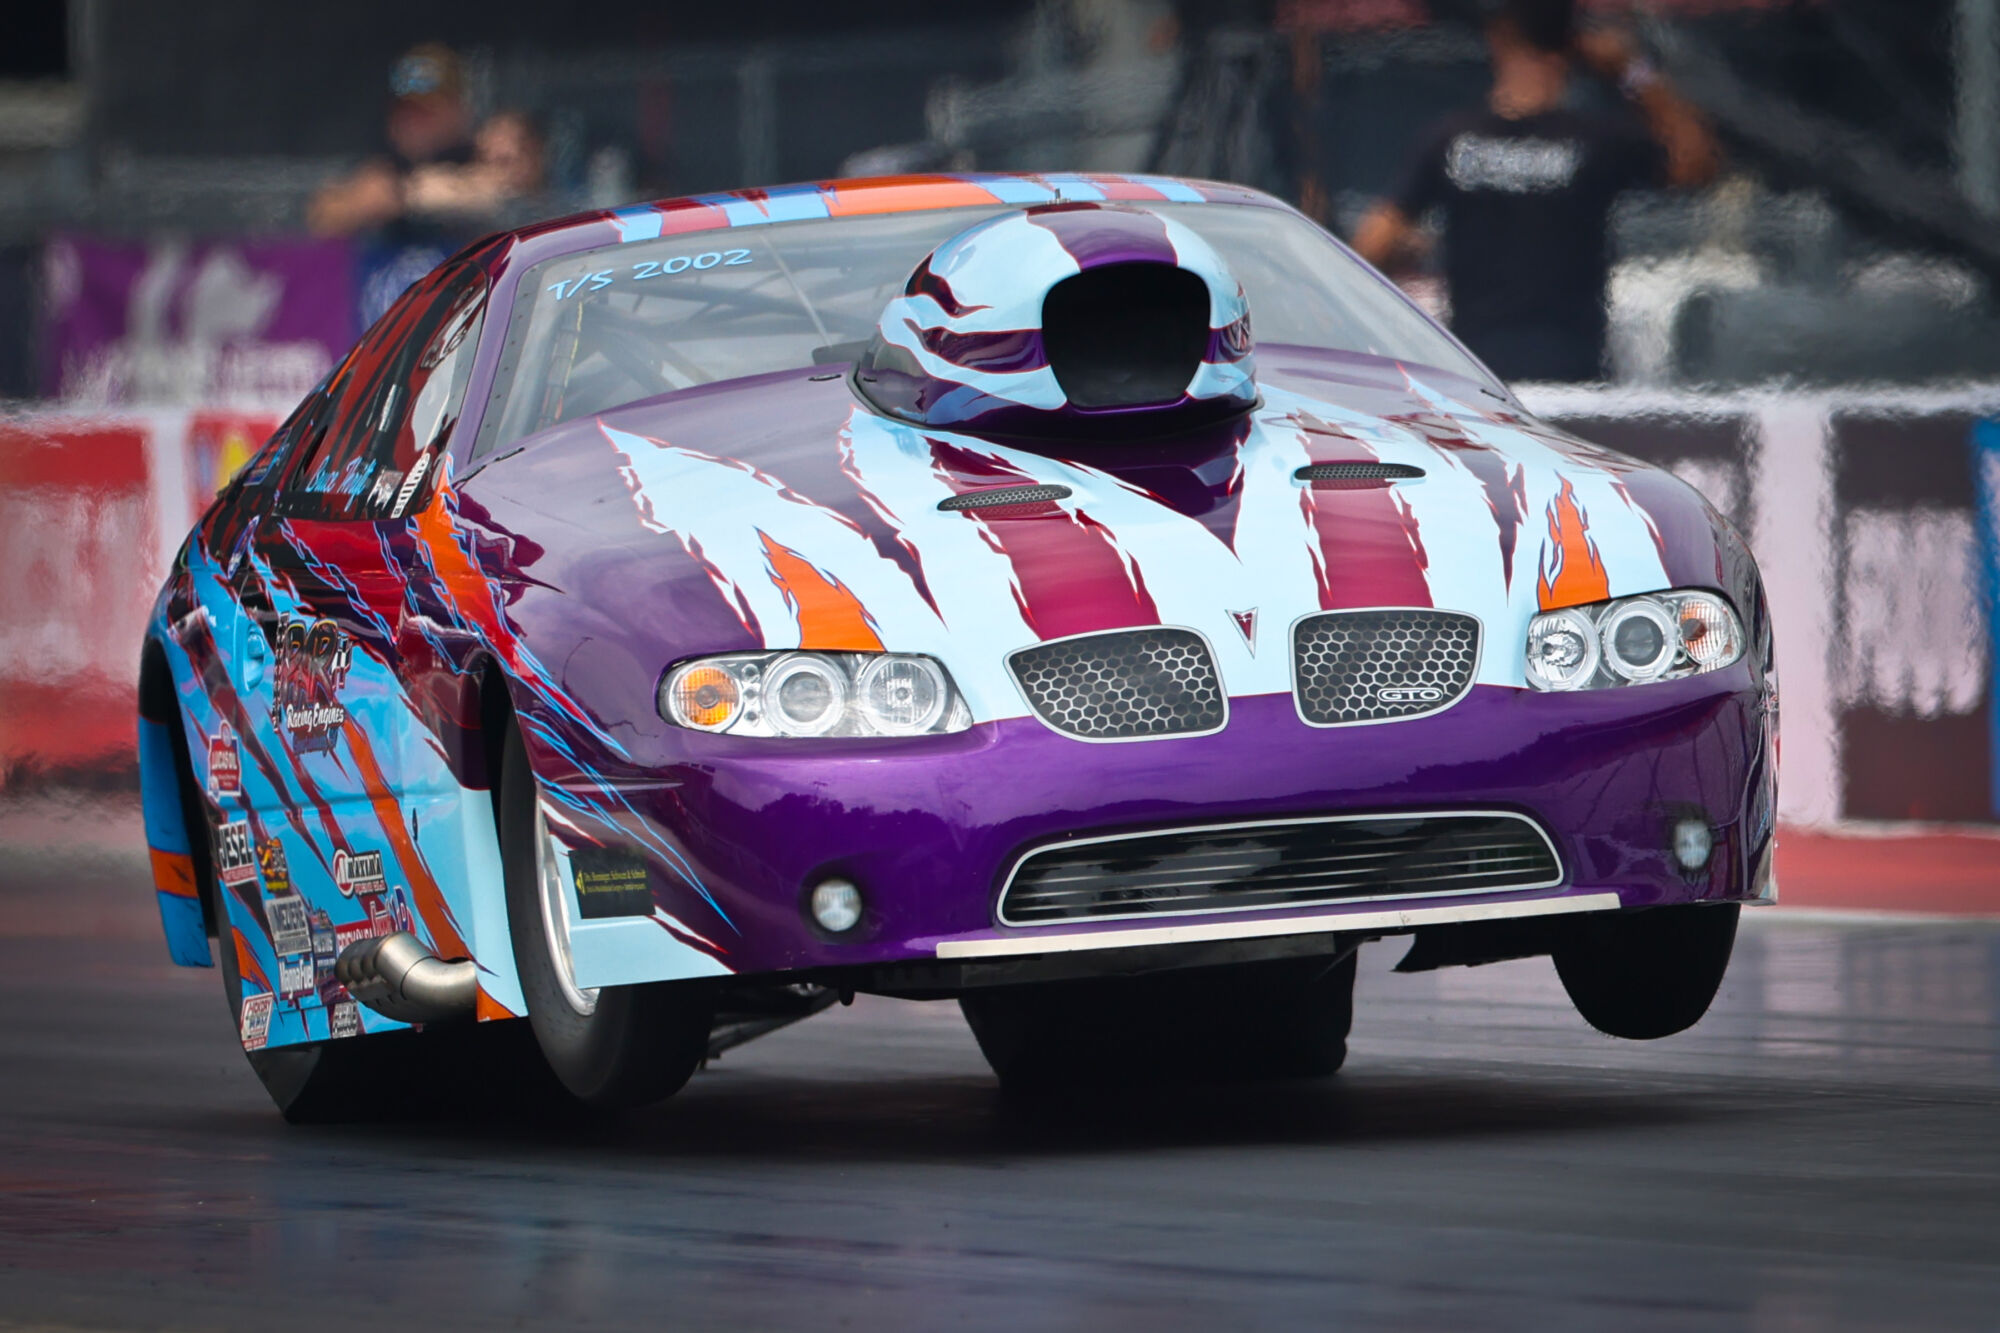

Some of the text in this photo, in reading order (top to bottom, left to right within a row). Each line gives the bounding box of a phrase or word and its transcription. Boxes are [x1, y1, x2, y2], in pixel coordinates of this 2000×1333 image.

[547, 248, 753, 301] T/S 2002
[1381, 689, 1440, 701] GTO
[286, 702, 345, 733] Racing Engines
[219, 823, 254, 868] JESEL
